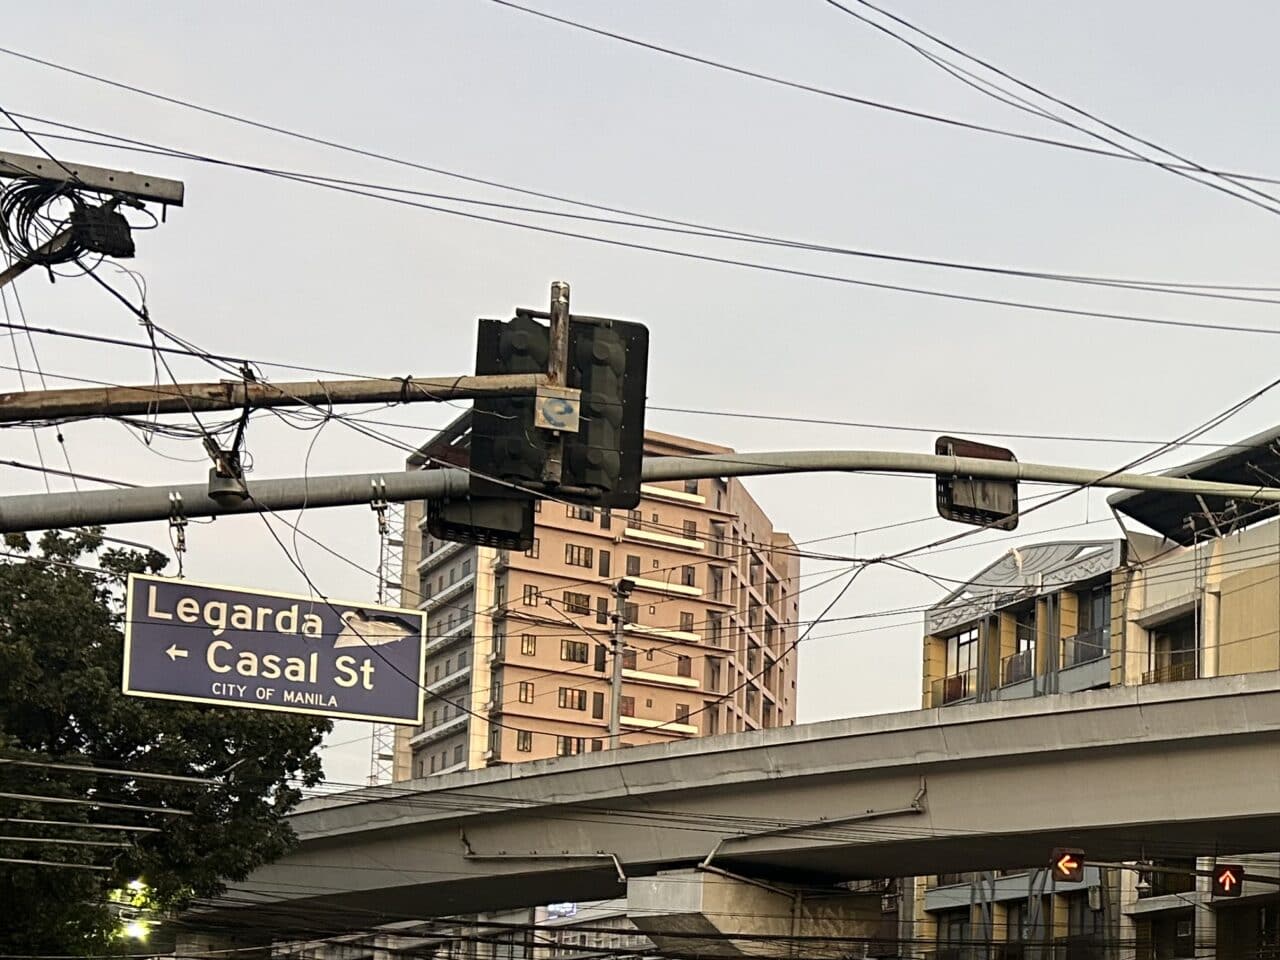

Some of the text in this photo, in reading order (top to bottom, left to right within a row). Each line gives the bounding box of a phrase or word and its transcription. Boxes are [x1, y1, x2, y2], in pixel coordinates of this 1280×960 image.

[147, 584, 323, 639] Legarda
[206, 639, 375, 690] Casal St
[211, 682, 338, 708] CITY OF MANILA
